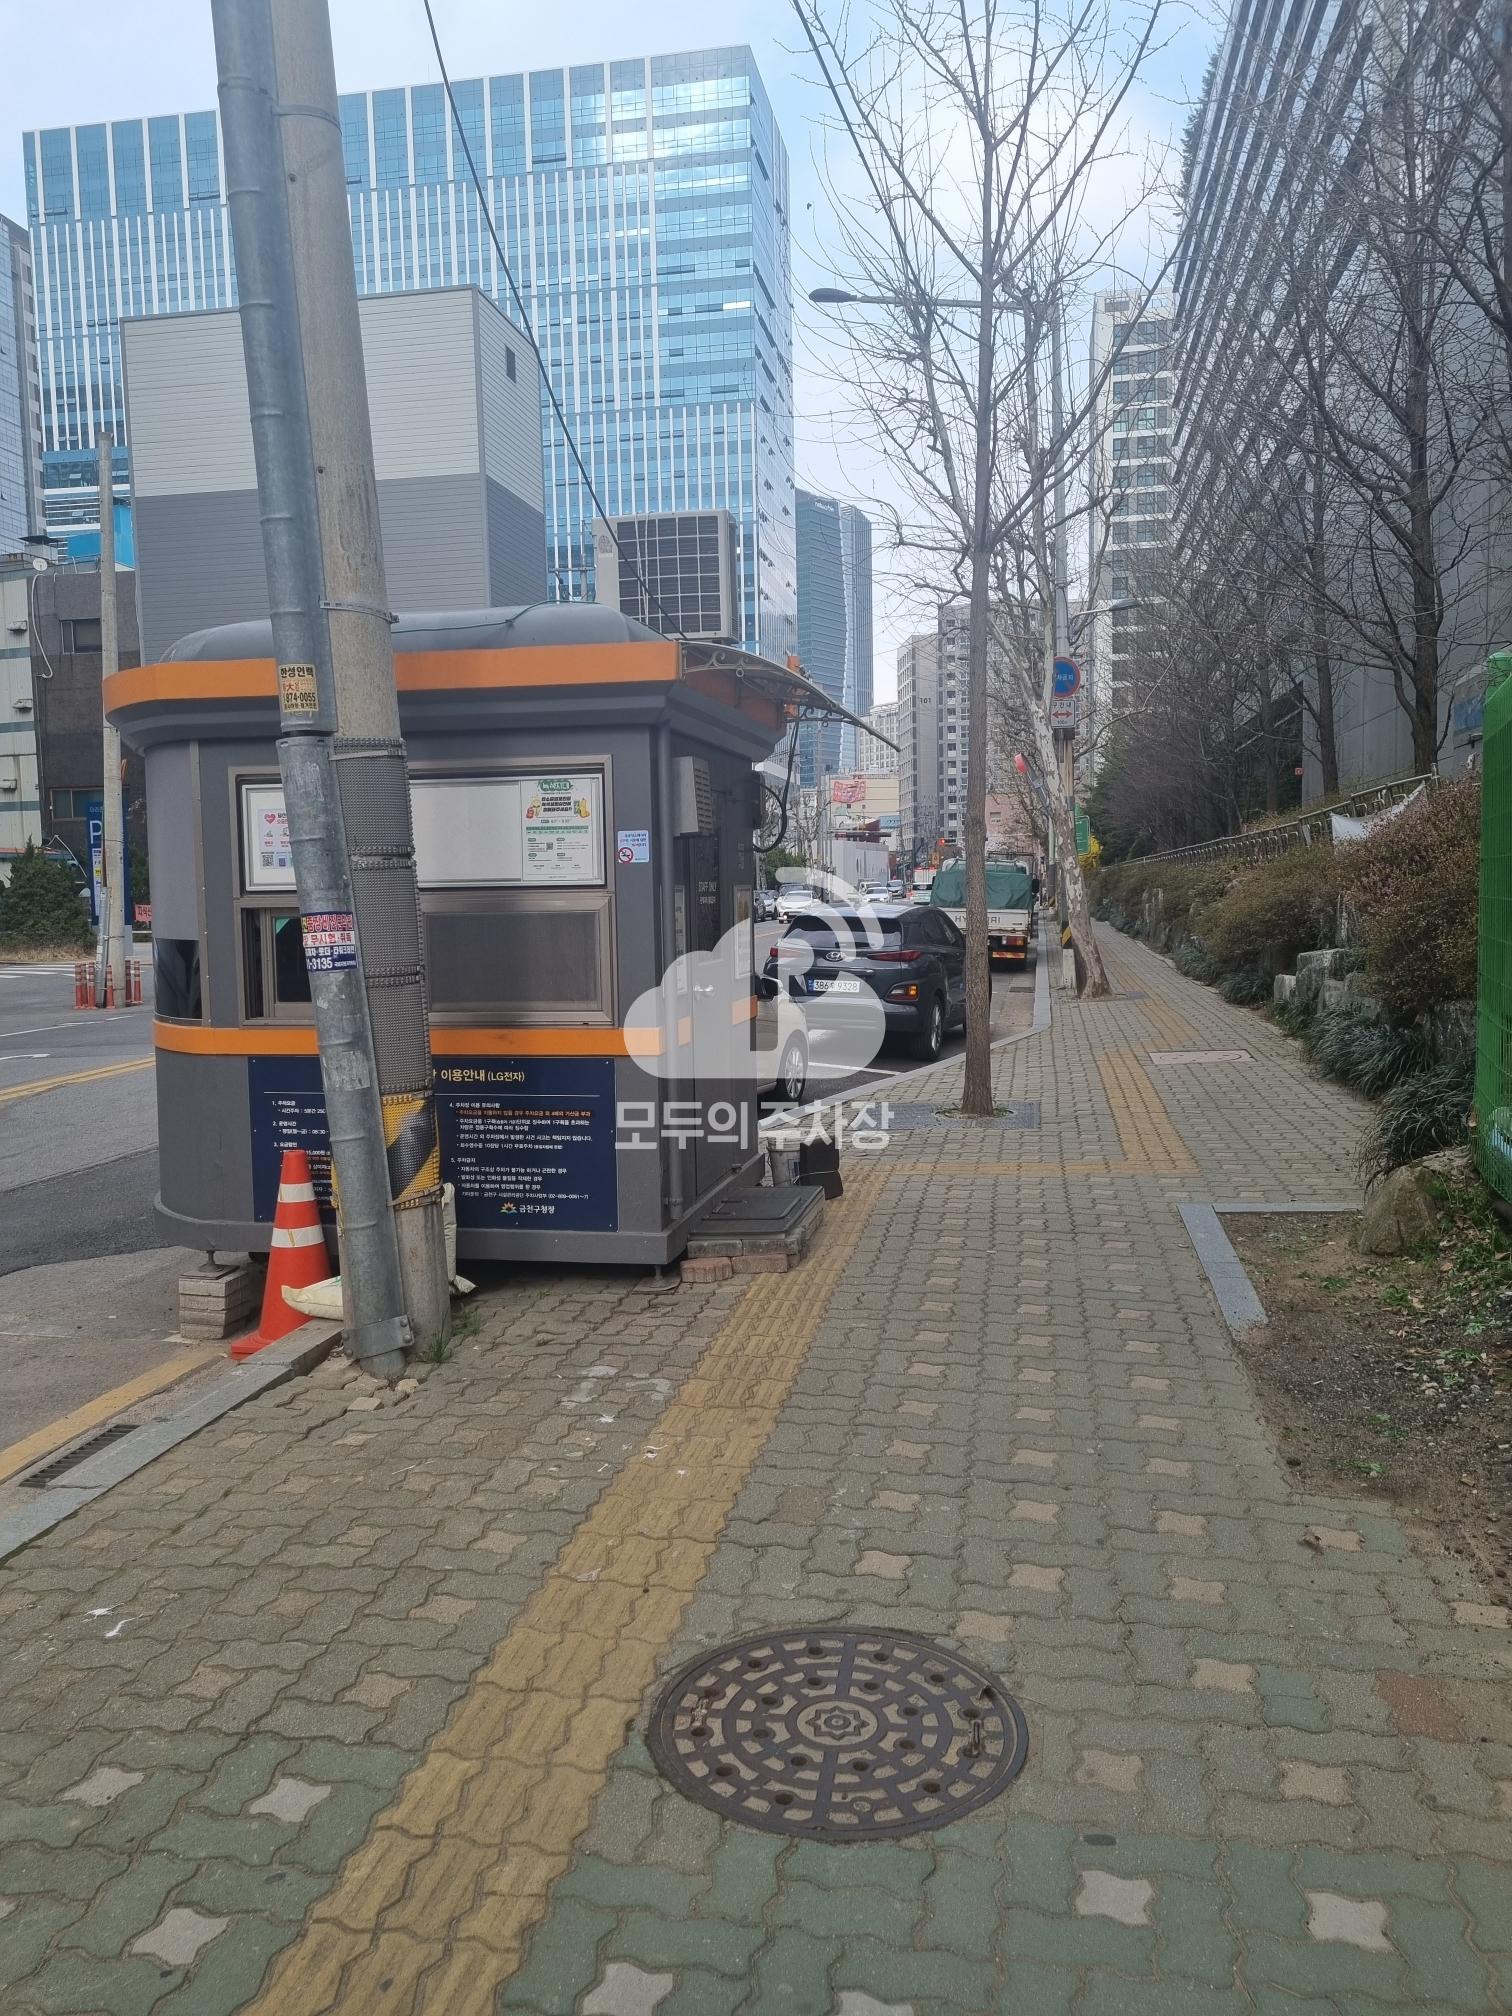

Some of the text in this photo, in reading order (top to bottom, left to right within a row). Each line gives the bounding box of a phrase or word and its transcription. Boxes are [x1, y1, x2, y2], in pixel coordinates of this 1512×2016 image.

[280, 666, 314, 678] 한성인력
[90, 820, 102, 844] P
[955, 915, 1000, 923] HYAI
[838, 982, 857, 991] 9328
[441, 1070, 485, 1082] 이용안내
[488, 1071, 524, 1082] (LG전자)
[519, 1204, 555, 1214] 금천구청장
